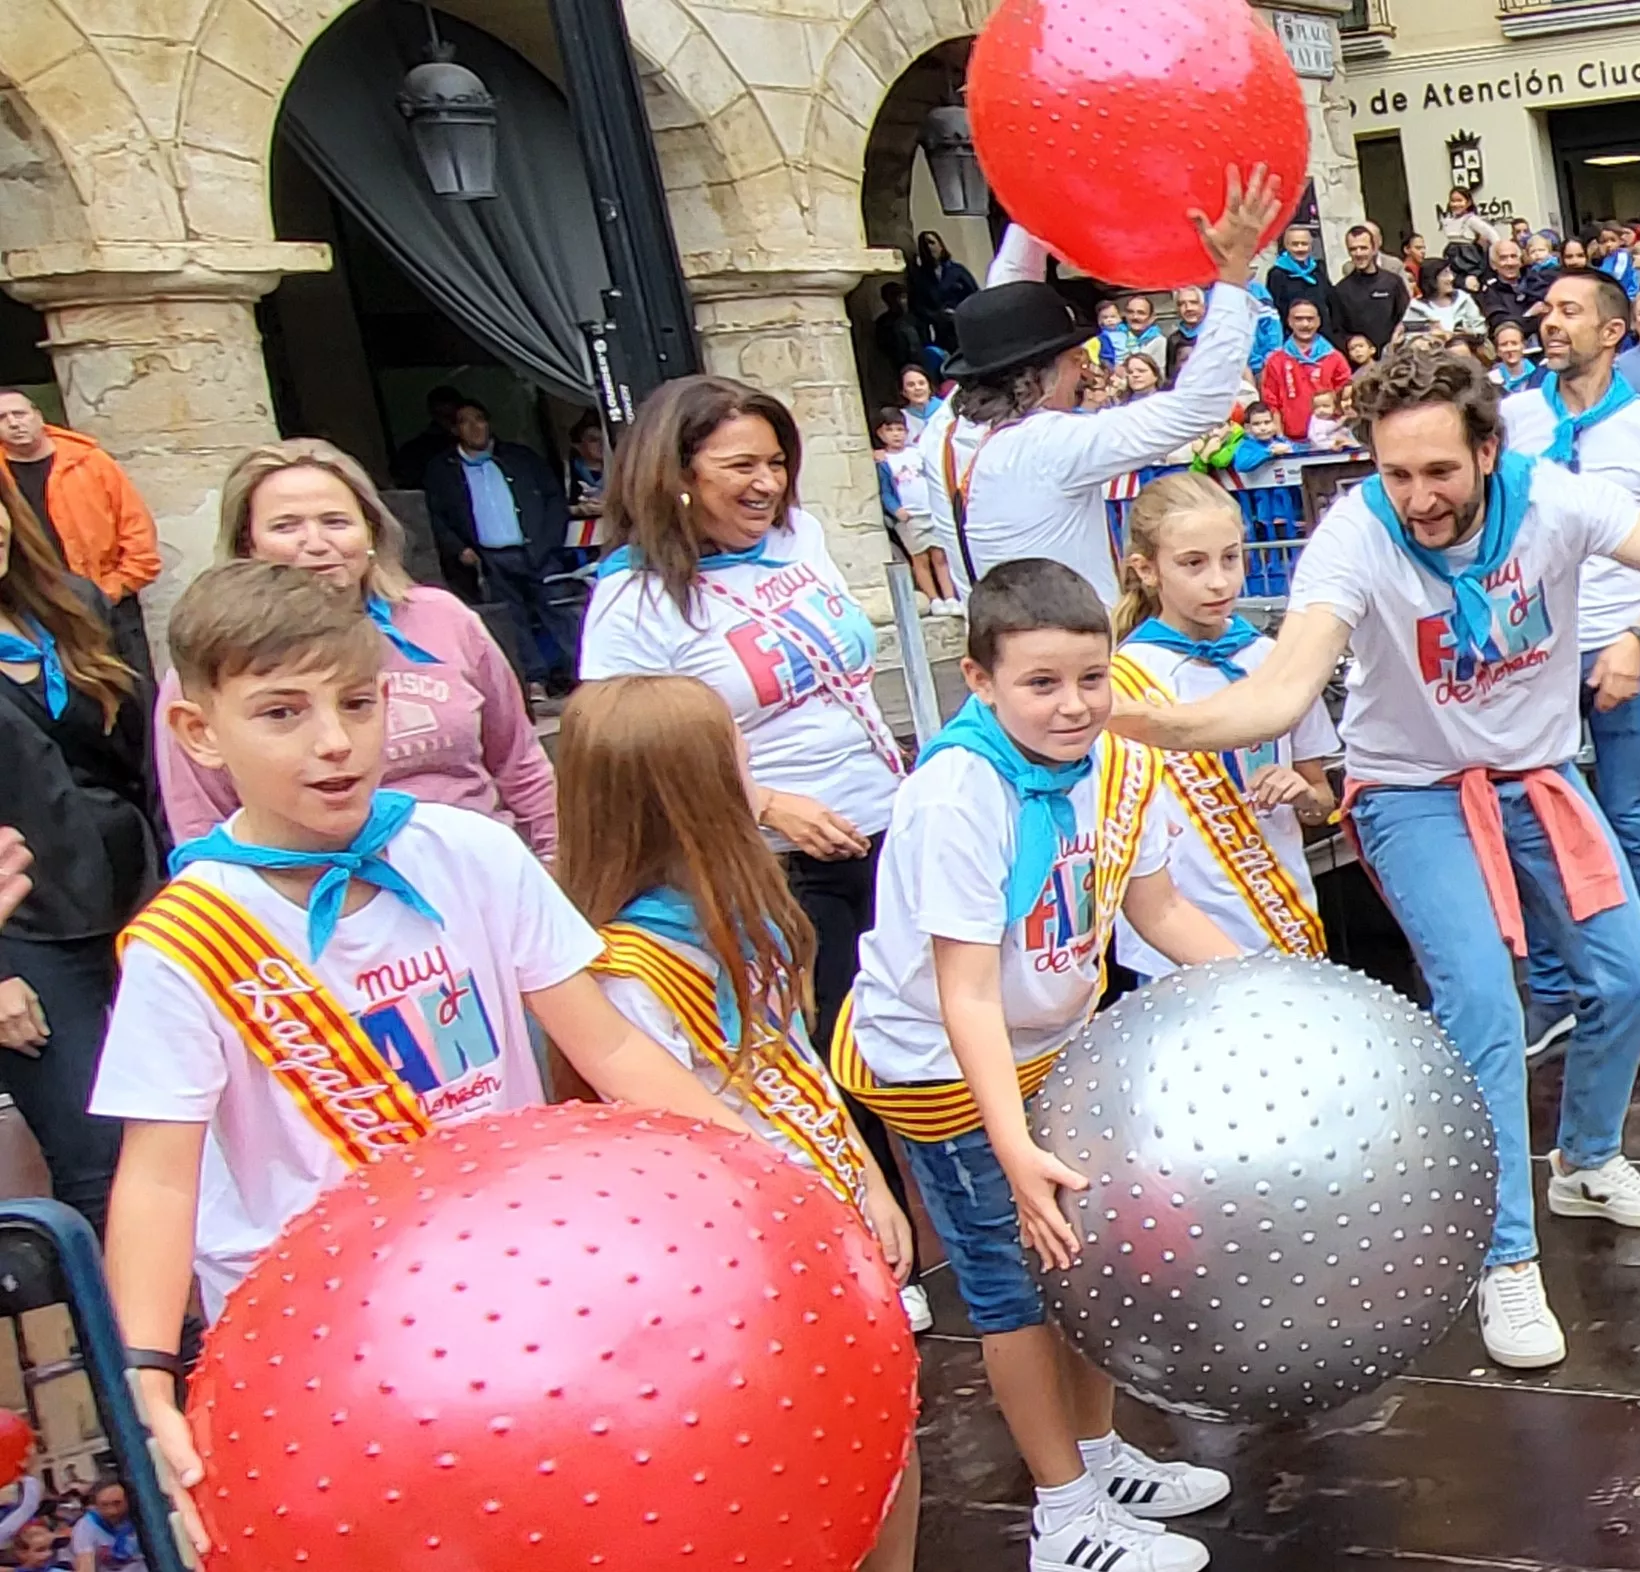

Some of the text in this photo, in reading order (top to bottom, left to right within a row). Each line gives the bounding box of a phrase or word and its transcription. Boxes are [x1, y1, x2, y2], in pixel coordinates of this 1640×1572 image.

[1371, 88, 1408, 114] de
[1422, 69, 1565, 109] Atención
[1436, 197, 1513, 226] Mzón
[356, 945, 469, 1025] muy
